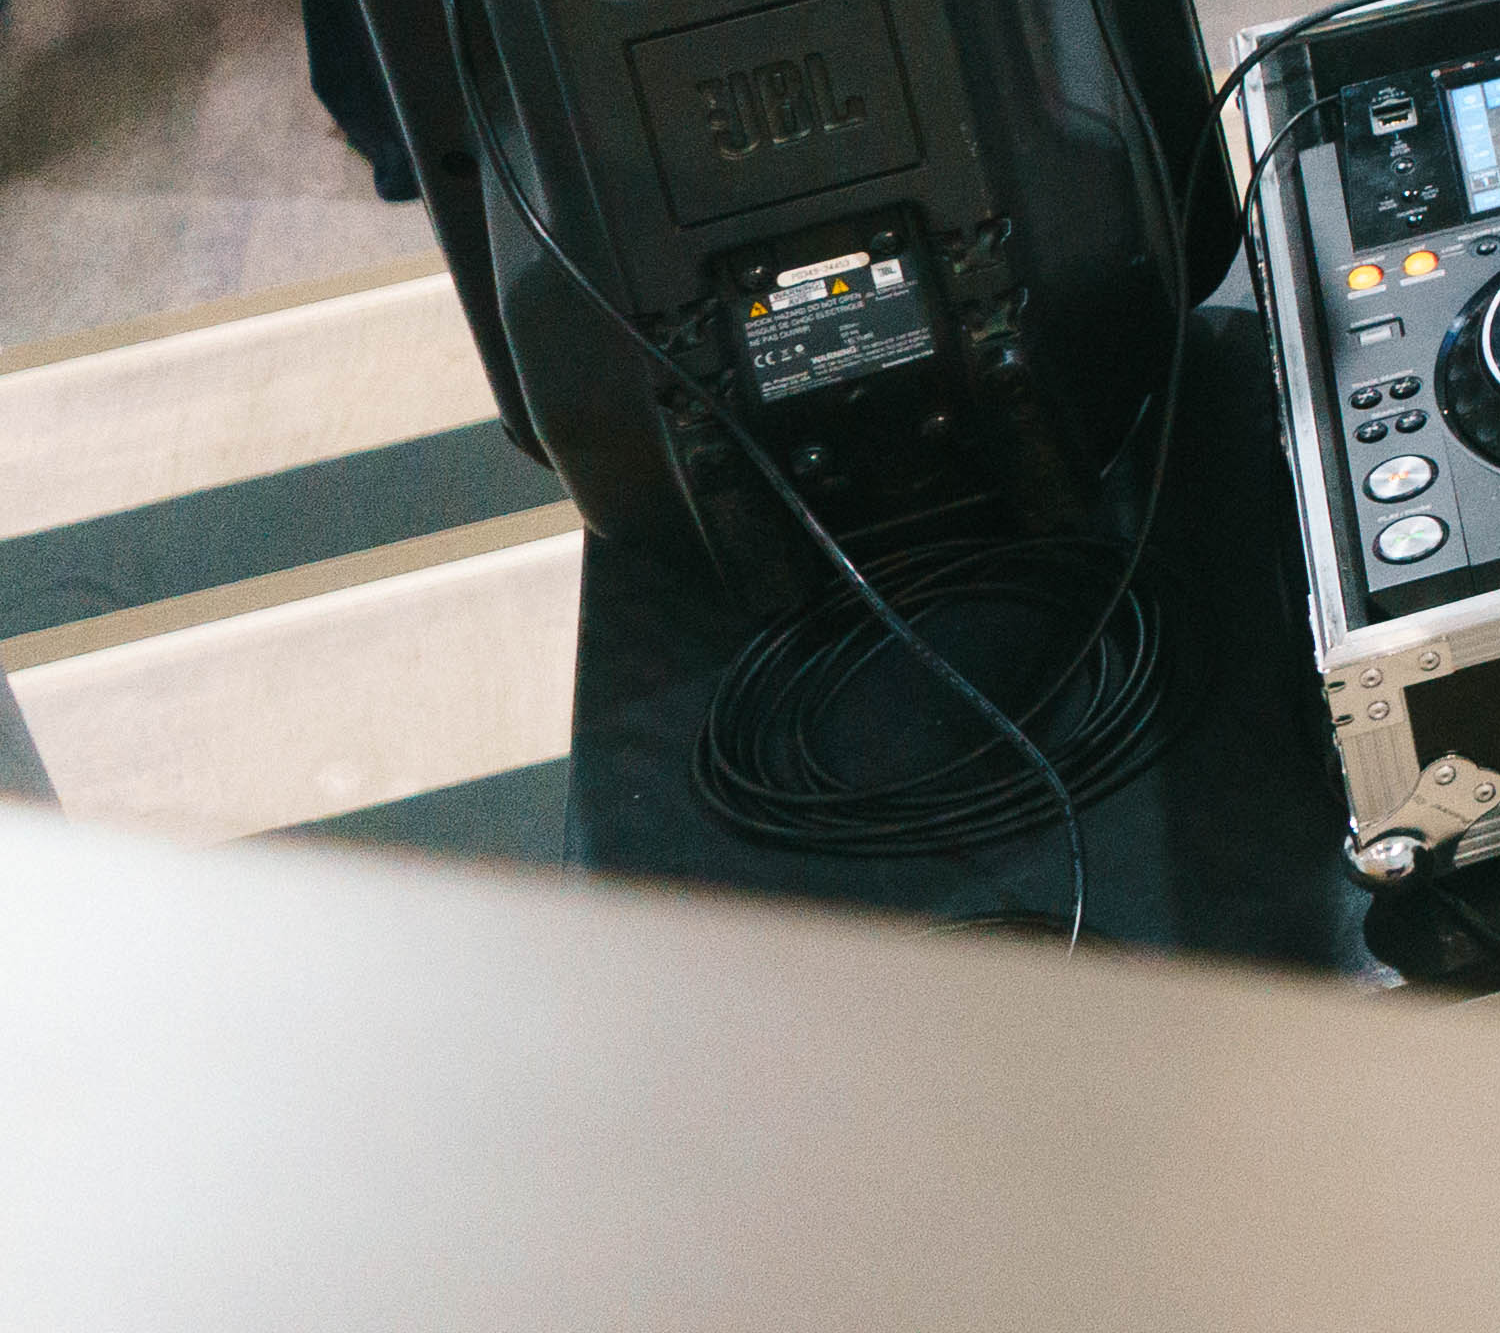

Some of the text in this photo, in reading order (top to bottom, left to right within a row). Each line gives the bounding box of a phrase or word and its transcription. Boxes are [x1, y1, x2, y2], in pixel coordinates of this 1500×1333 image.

[701, 52, 867, 162] JBL
[774, 307, 807, 321] HAZARD
[807, 302, 820, 314] DO
[821, 298, 837, 310] NOT
[838, 292, 863, 305] OPEN
